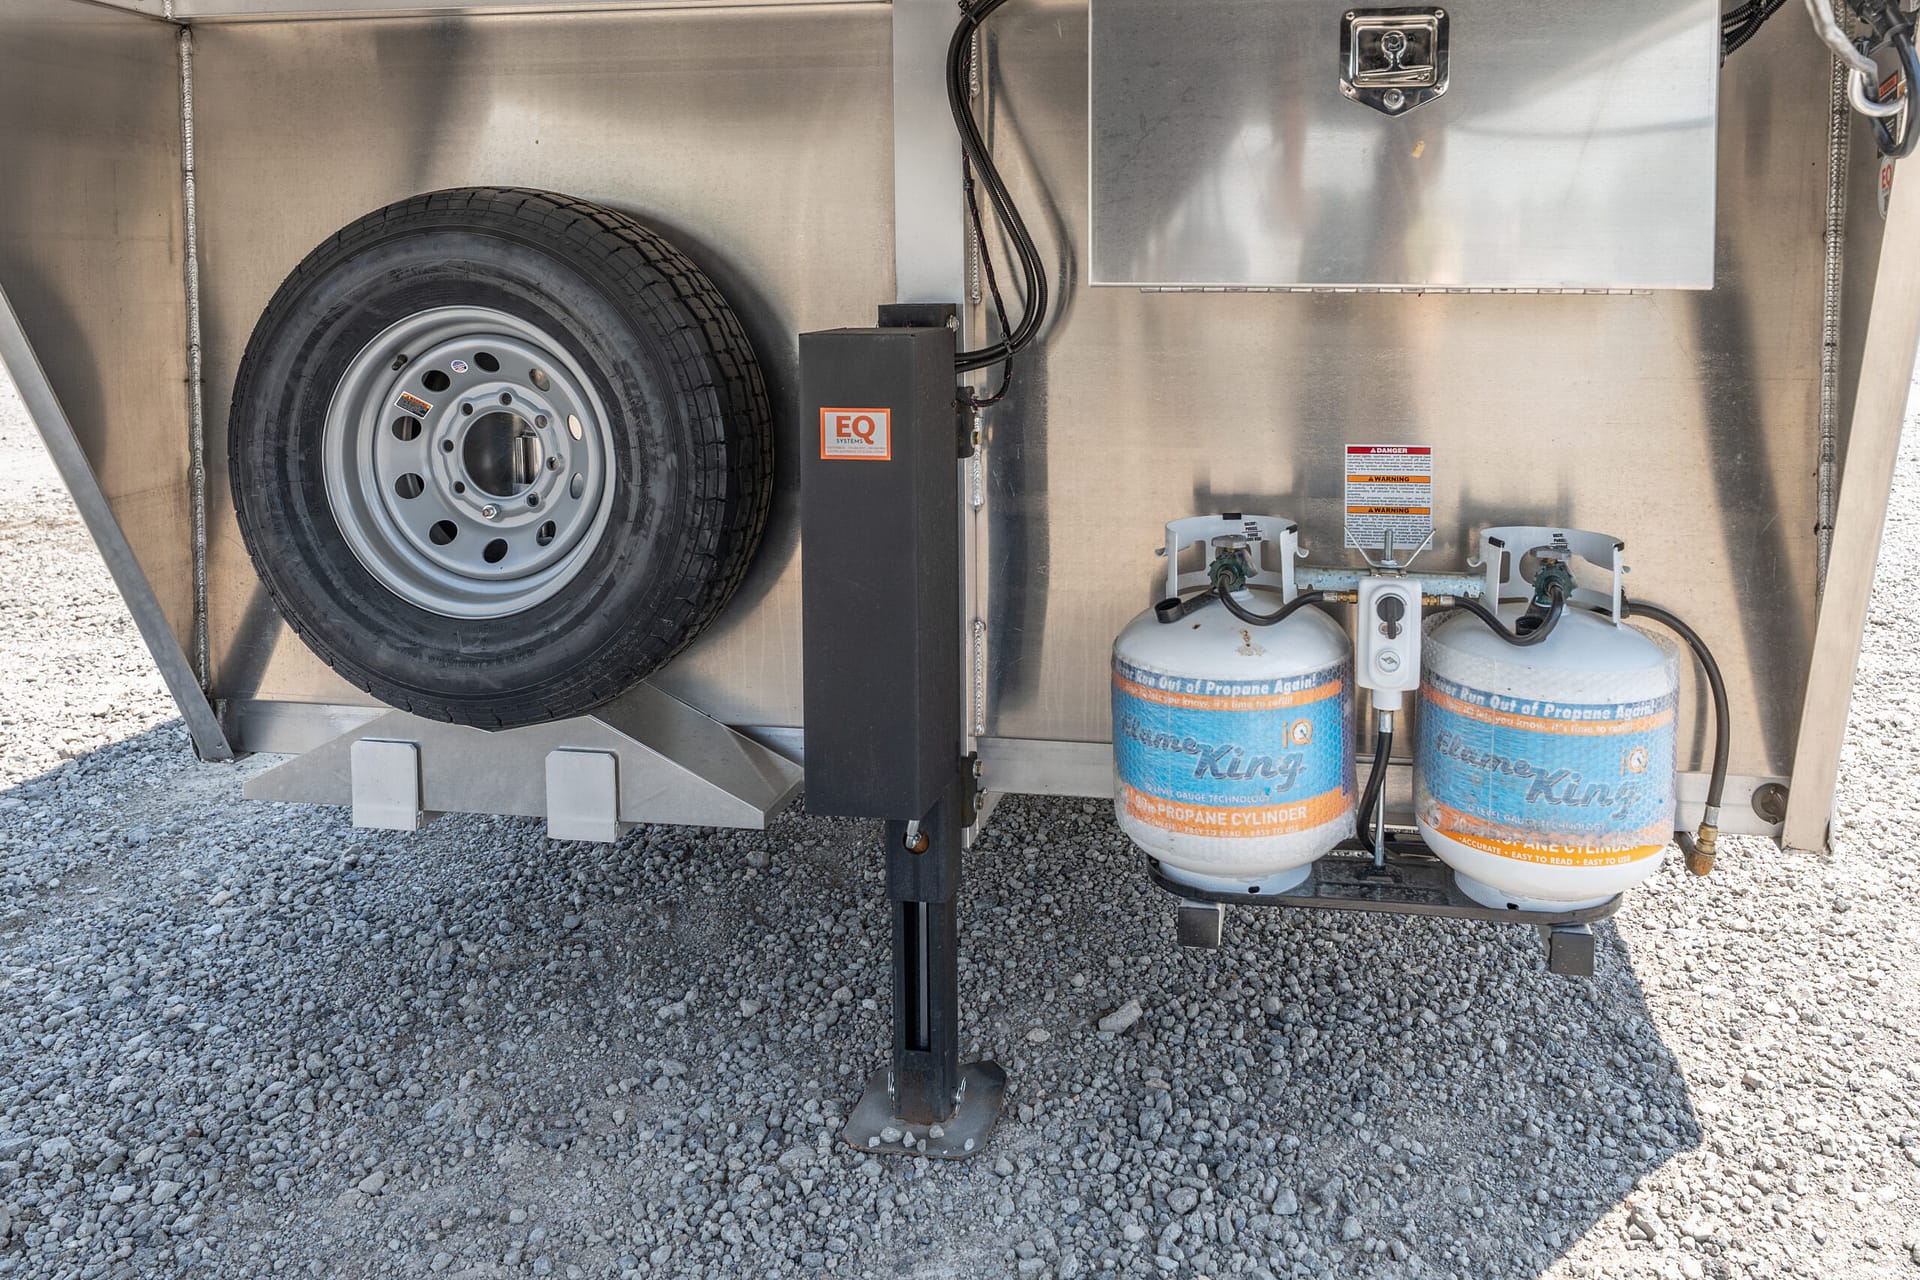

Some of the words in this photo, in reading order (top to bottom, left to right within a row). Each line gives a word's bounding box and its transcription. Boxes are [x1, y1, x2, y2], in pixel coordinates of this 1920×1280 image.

[836, 415, 875, 445] EQ
[1135, 670, 1155, 688] Run
[1159, 676, 1182, 692] Out
[1186, 680, 1202, 693] of
[1206, 681, 1269, 698] Propane
[1273, 674, 1316, 695] Again!
[1164, 696, 1180, 706] you
[1460, 686, 1485, 706] Run
[1490, 695, 1517, 712] Out
[1521, 702, 1540, 715] of
[1543, 703, 1611, 721] Propane
[1614, 700, 1656, 720] Again!
[1495, 717, 1513, 725] you
[1596, 725, 1606, 733] to
[1120, 713, 1204, 755] Flame
[1194, 743, 1306, 793] King
[1436, 728, 1537, 779] Flame
[1525, 766, 1643, 820] King
[1176, 790, 1206, 803] GAUGE
[1209, 793, 1272, 804] TECHNOLOGY
[1158, 803, 1227, 827] PROPANE
[1231, 805, 1307, 826] CYLINDER
[1461, 837, 1502, 855] ACCURATE
[1511, 850, 1534, 861] EASY
[1535, 855, 1548, 863] TO
[1550, 856, 1573, 866] READ
[1583, 857, 1604, 866] EASY
[1605, 856, 1617, 864] TO
[1618, 854, 1631, 864] USE
